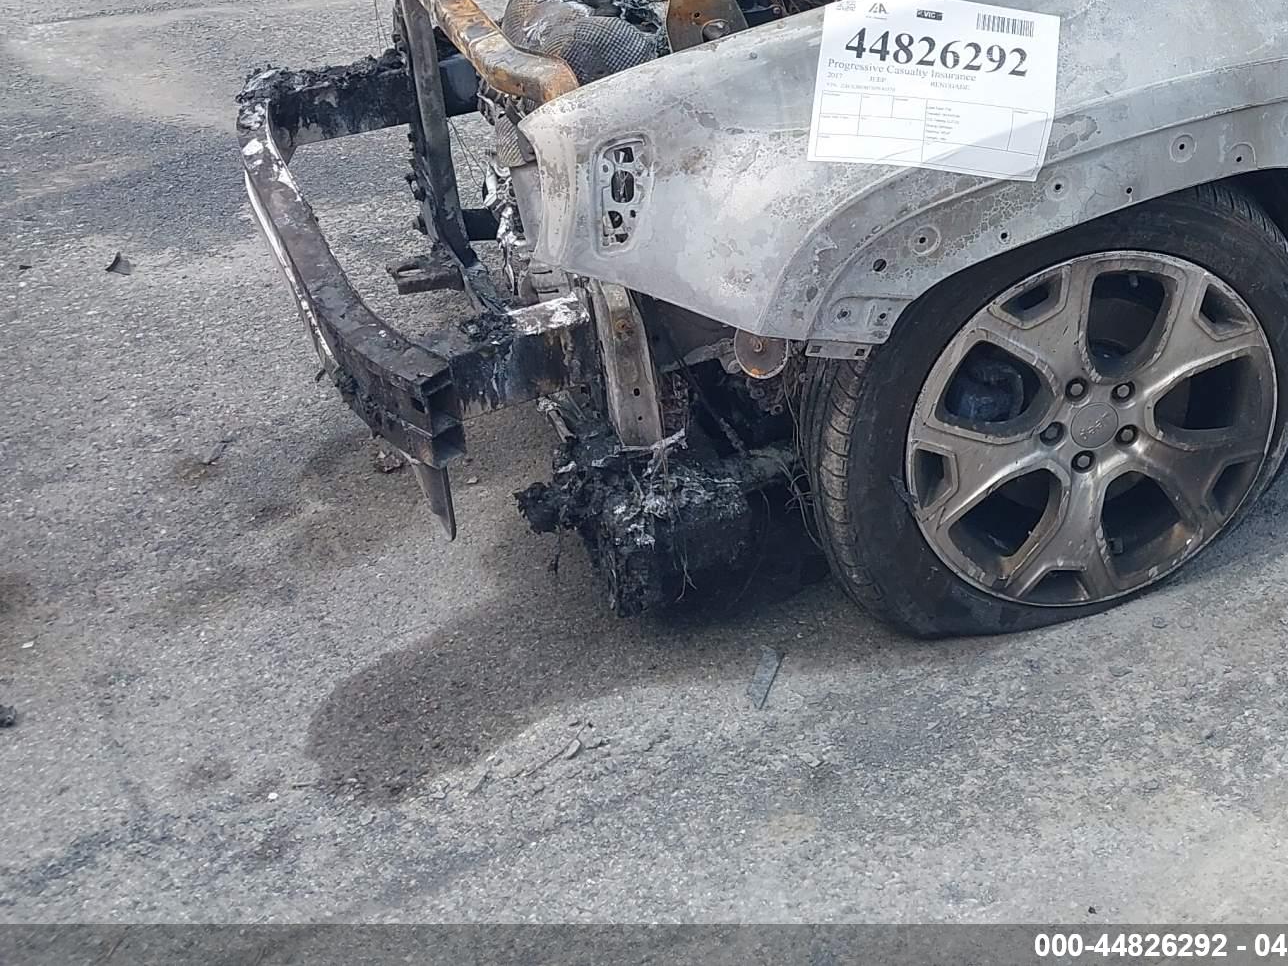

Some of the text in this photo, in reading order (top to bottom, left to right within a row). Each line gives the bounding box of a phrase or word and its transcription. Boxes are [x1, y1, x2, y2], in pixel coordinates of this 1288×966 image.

[828, 58, 976, 81] Progressive Casualty Insurance
[845, 27, 1028, 77] 44826292
